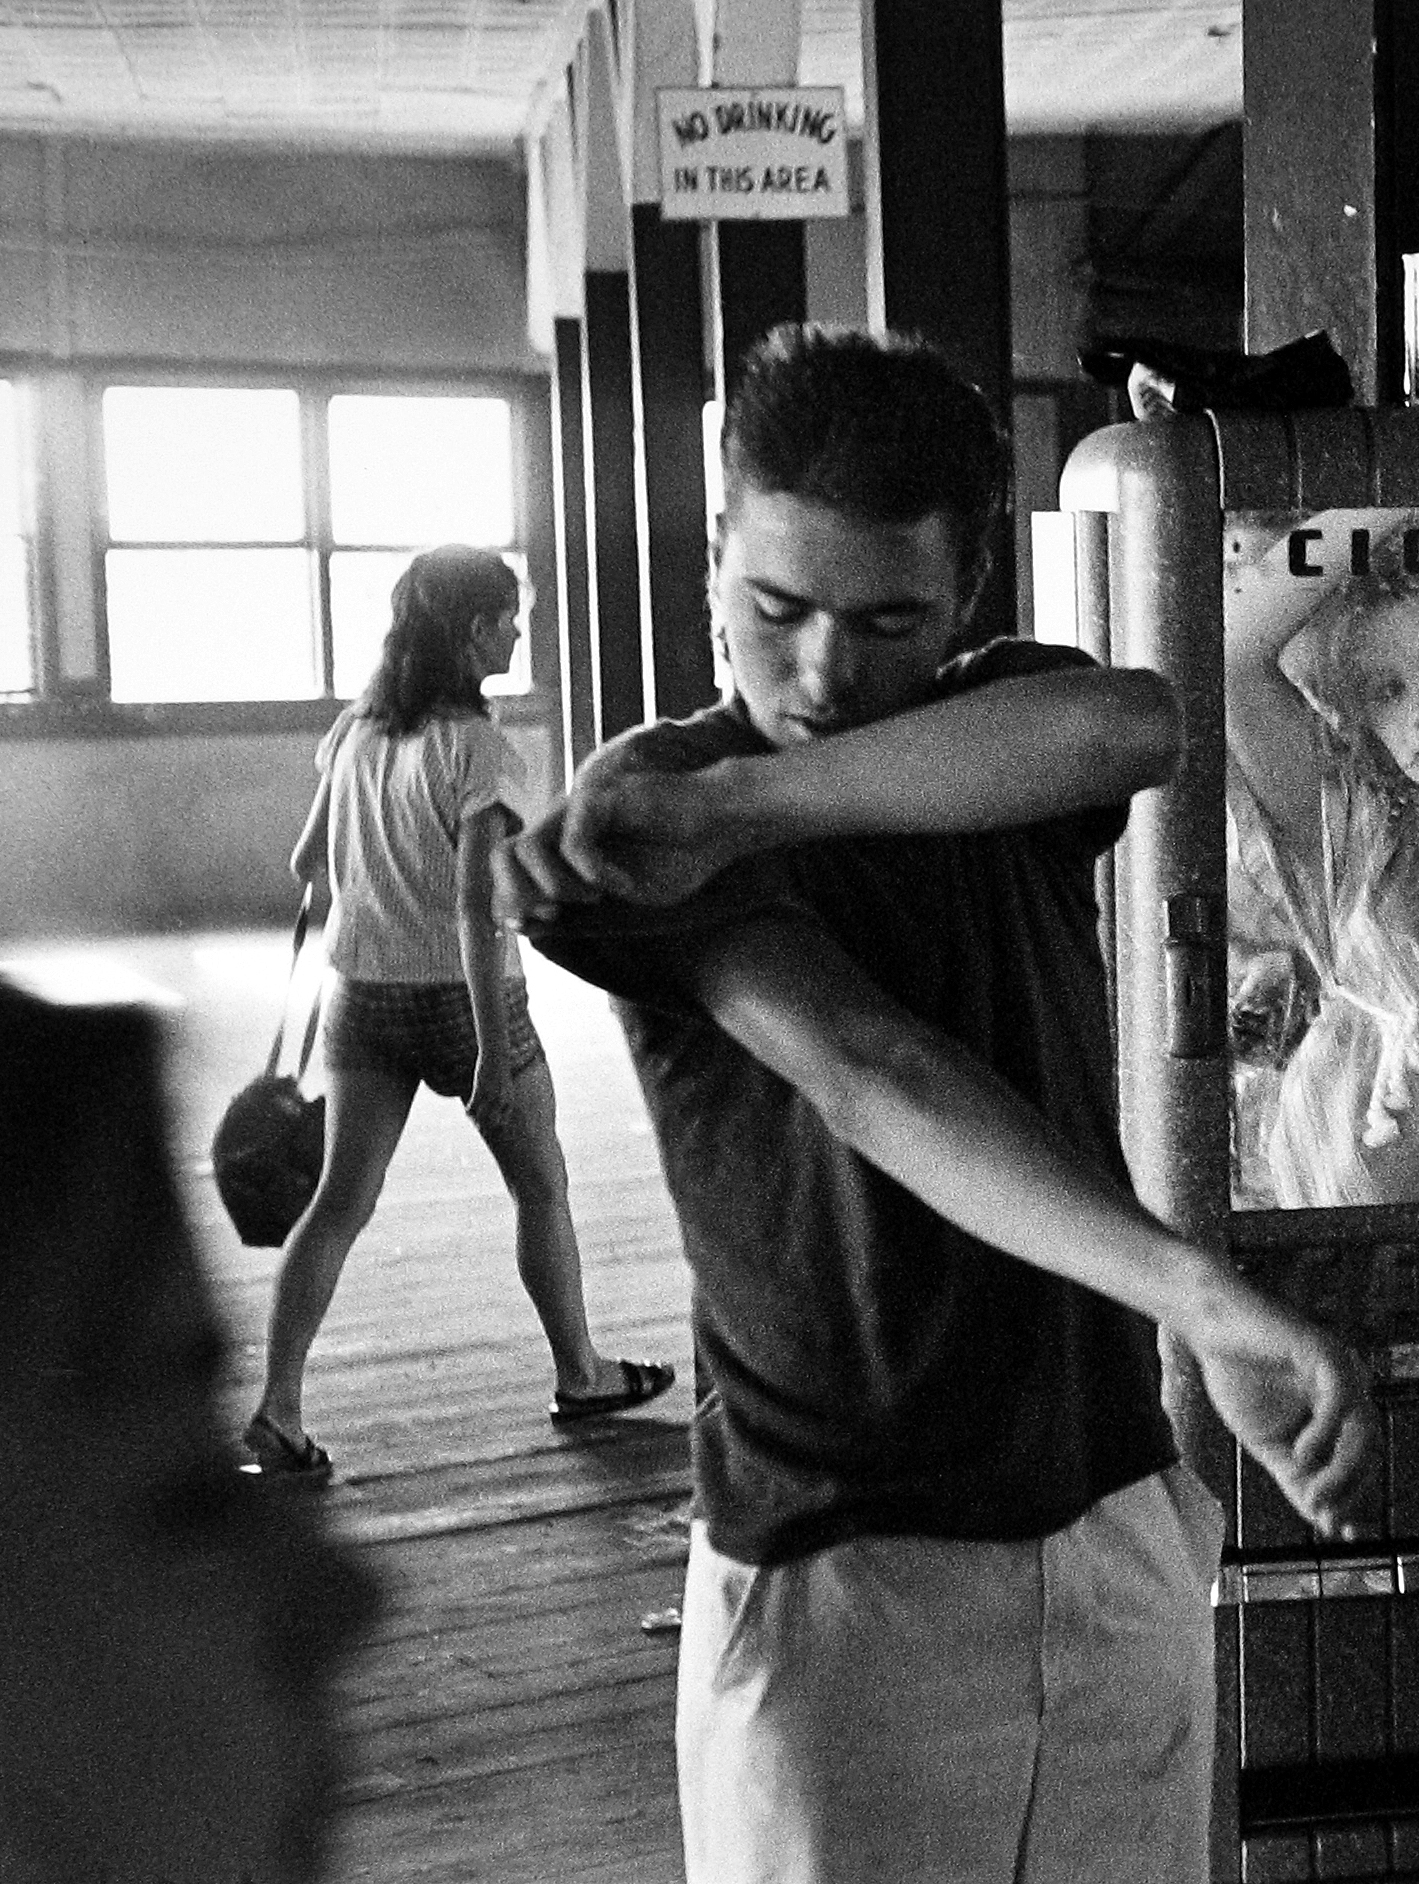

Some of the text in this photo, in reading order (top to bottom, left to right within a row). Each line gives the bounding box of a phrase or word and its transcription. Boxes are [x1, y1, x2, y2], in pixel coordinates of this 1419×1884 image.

[672, 102, 837, 149] NO DRINKING
[674, 165, 831, 194] IN THIS AREA
